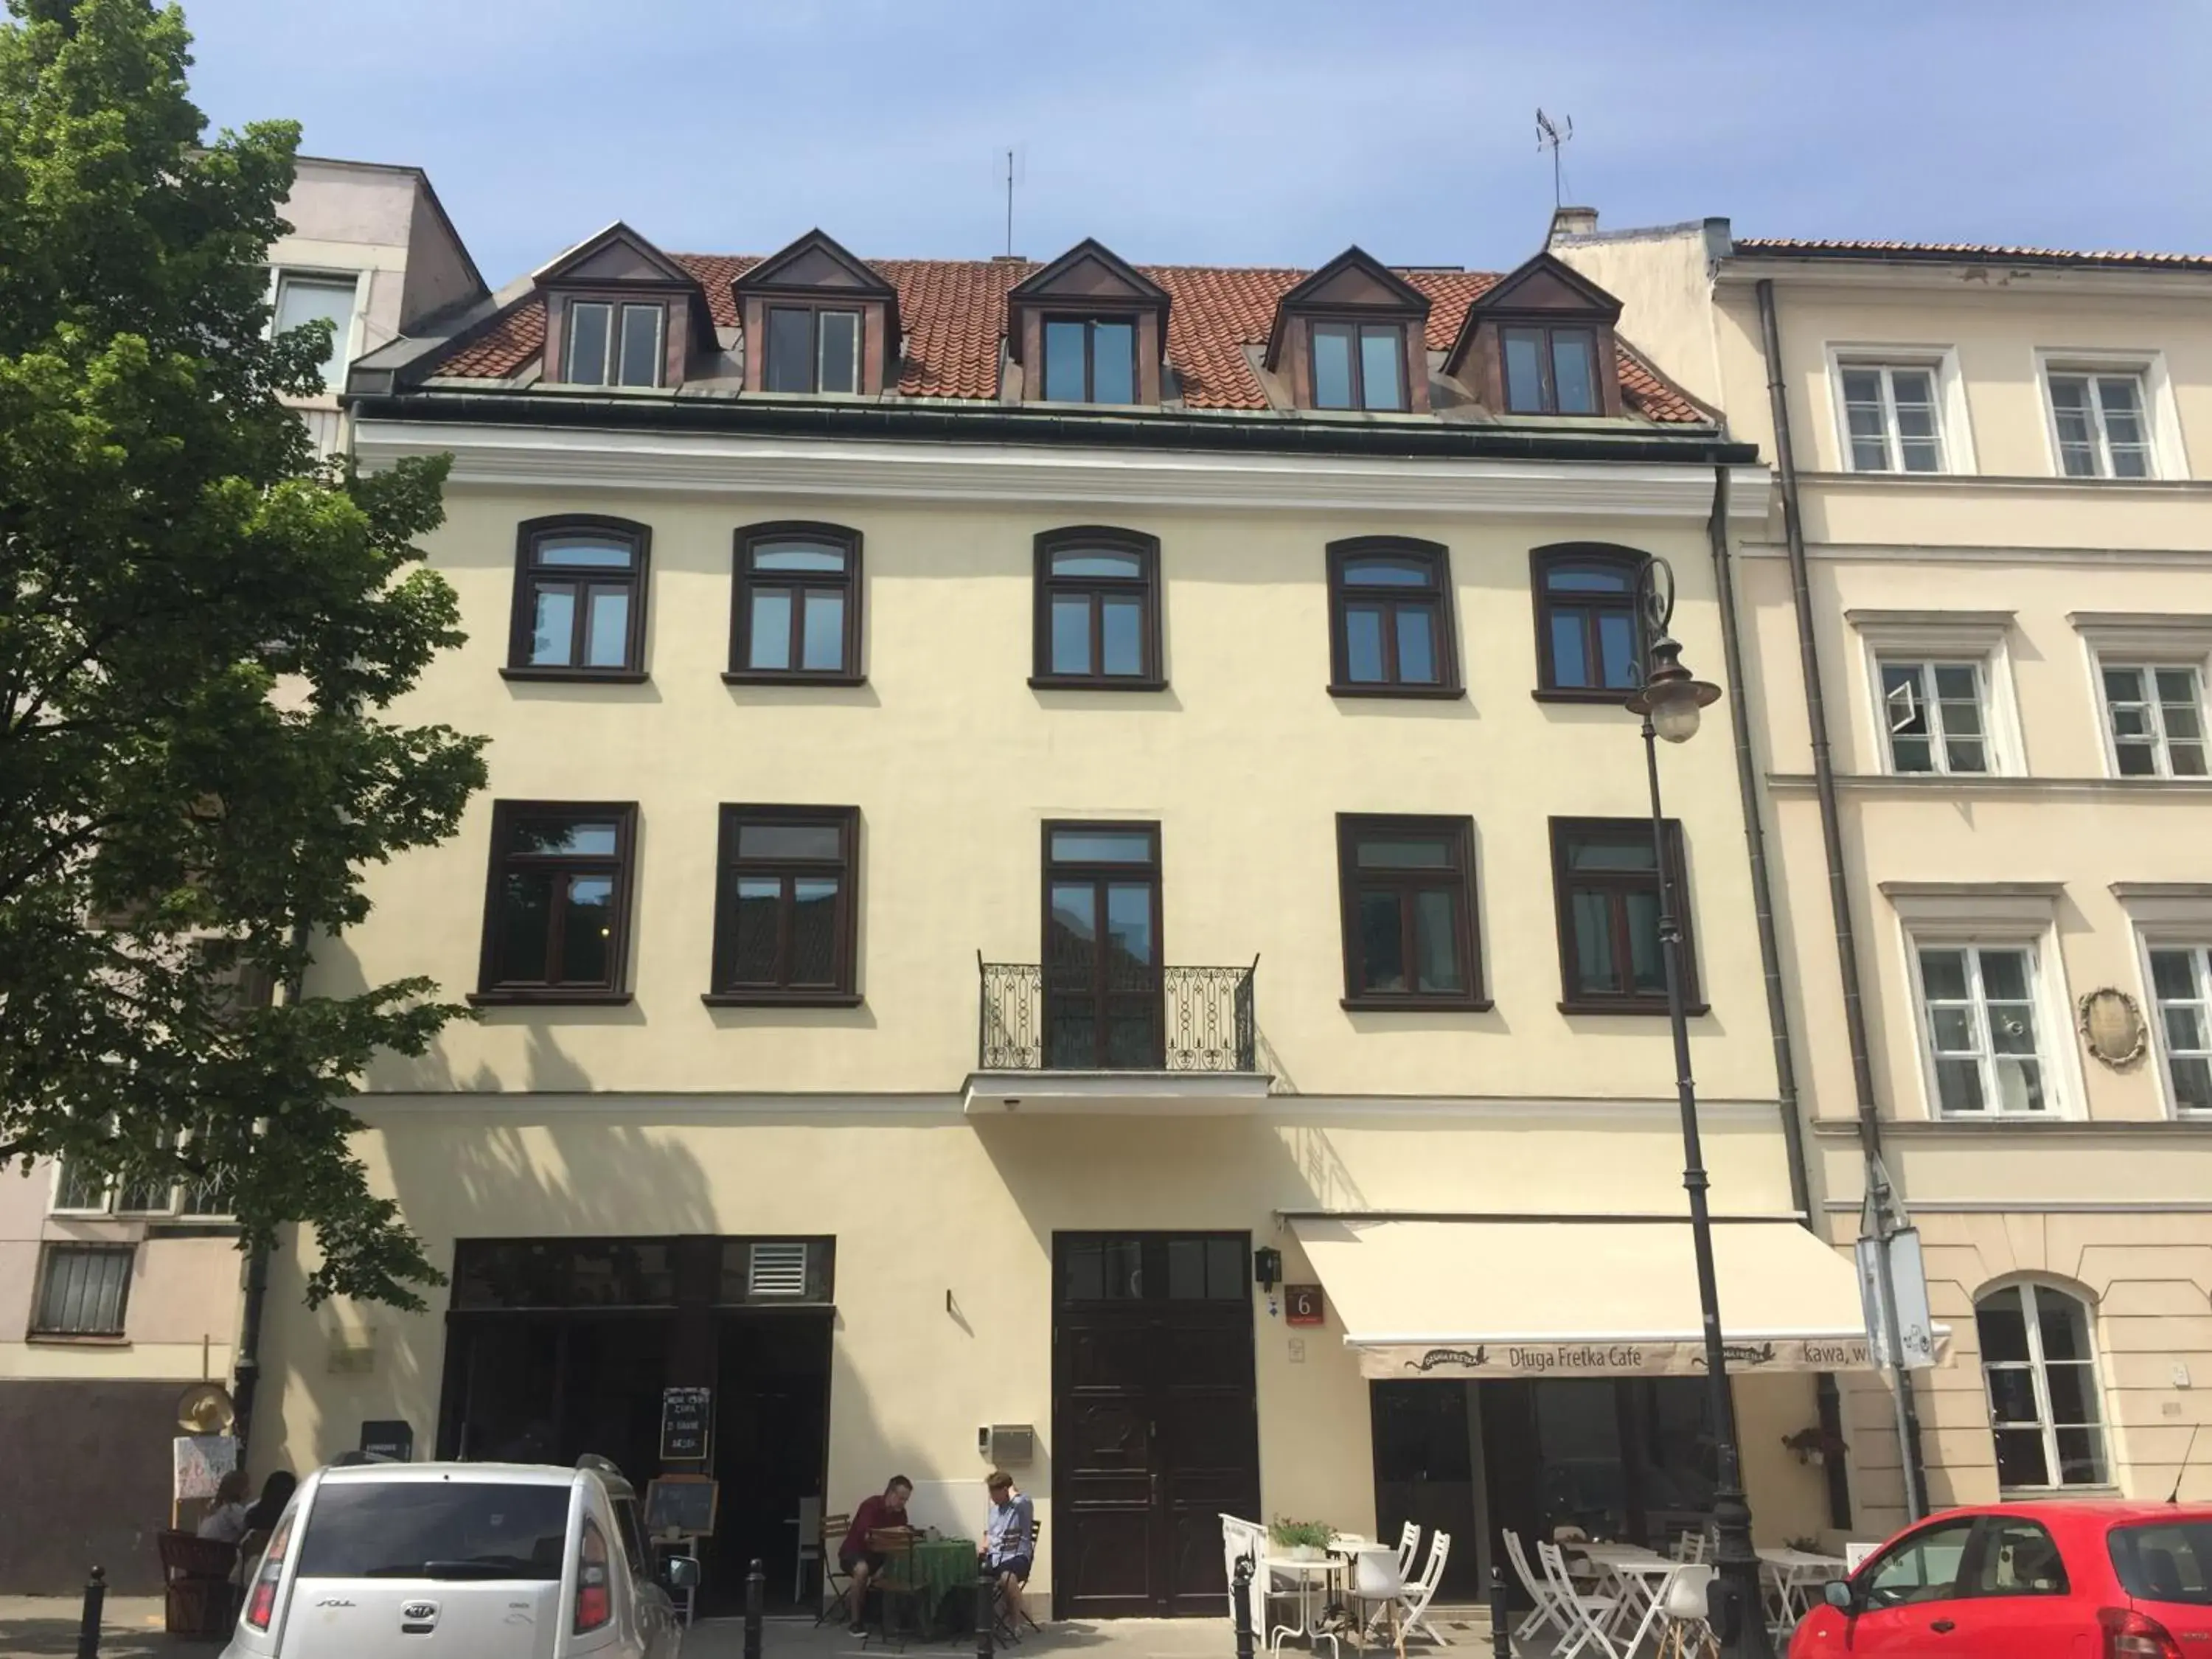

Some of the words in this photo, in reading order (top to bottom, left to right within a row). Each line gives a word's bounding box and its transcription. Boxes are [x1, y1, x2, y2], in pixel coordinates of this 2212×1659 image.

[1298, 1294, 1310, 1315] 6
[1509, 1346, 1554, 1372] Długa
[1557, 1346, 1606, 1368] Fretka
[1804, 1340, 1849, 1365] kawa,
[406, 1605, 434, 1618] KIA
